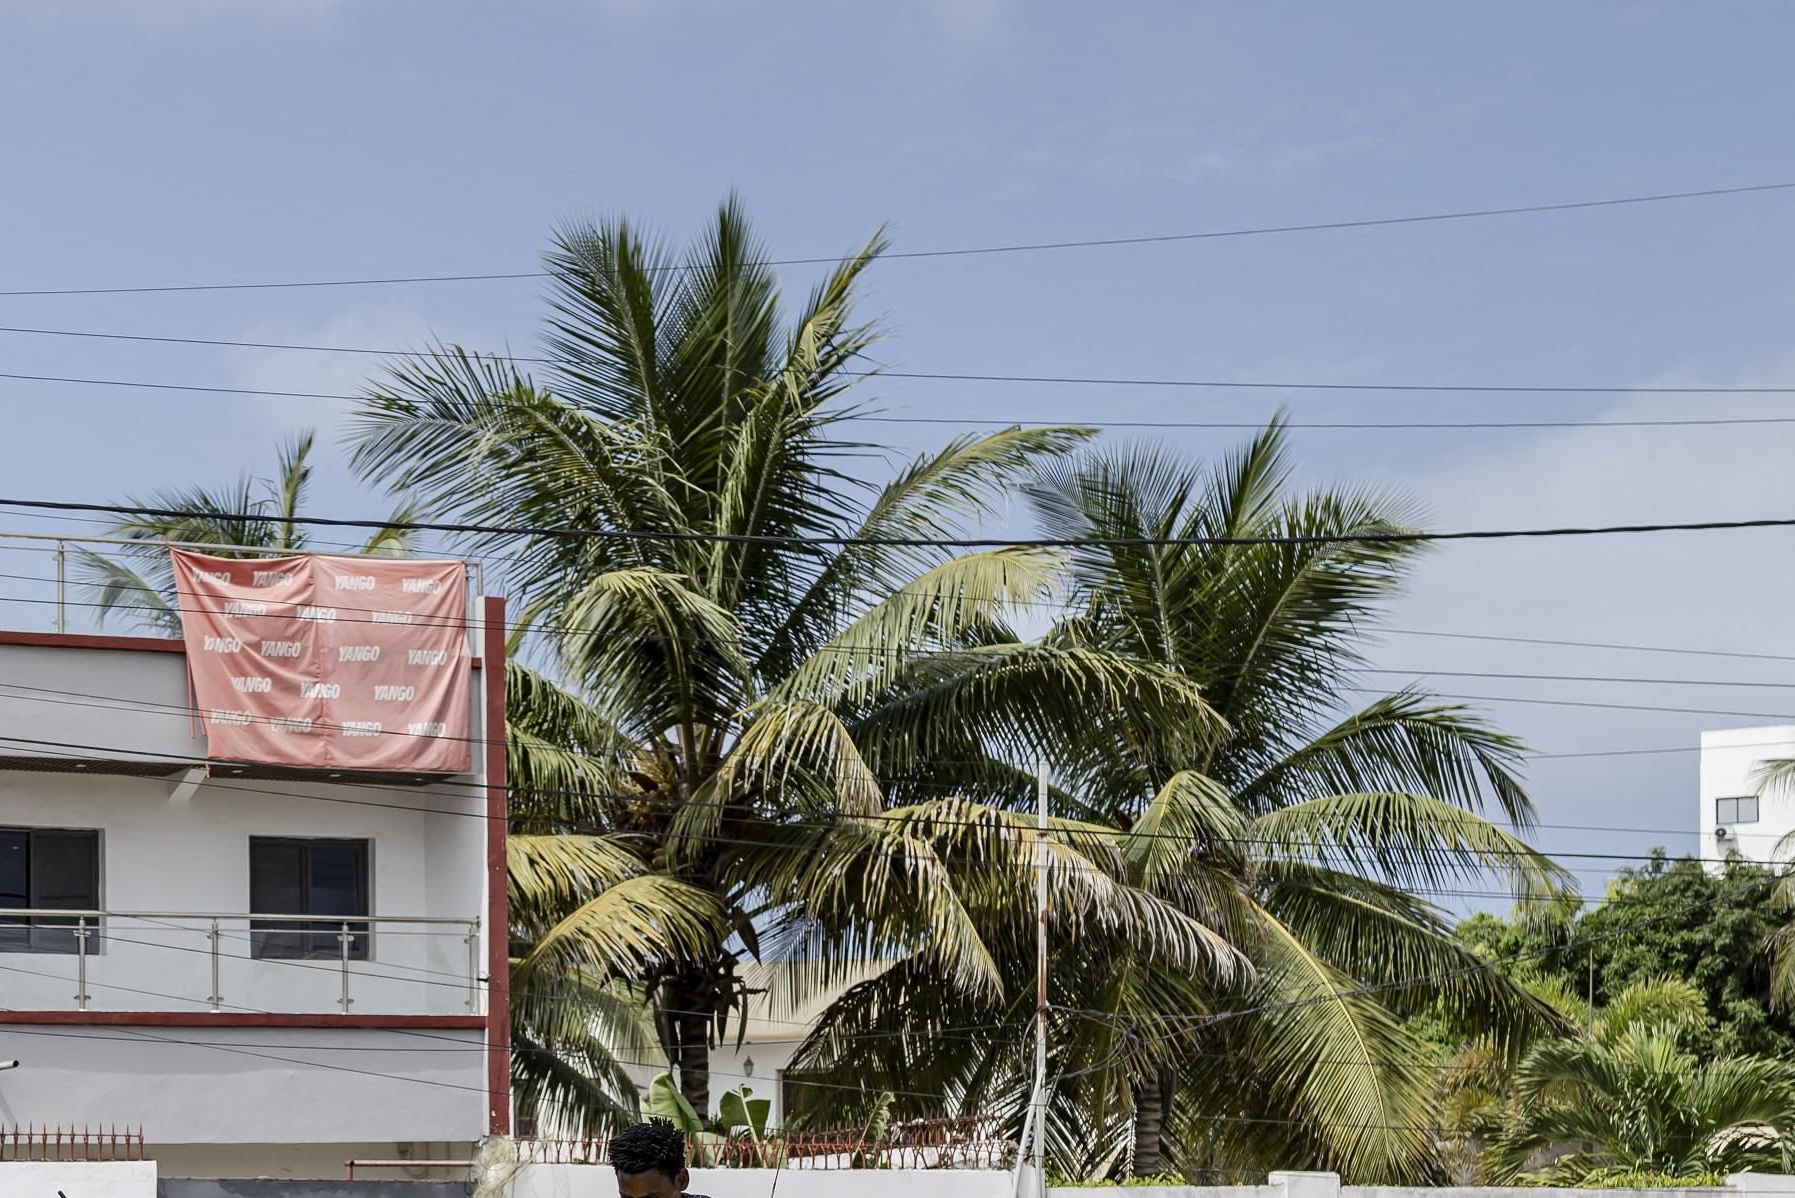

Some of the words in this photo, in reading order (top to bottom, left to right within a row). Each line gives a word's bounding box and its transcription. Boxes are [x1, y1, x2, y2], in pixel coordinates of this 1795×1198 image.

[252, 571, 294, 587] YANGO
[335, 576, 375, 590] YANGO
[402, 579, 442, 594] YANGO
[297, 606, 336, 623] YANGO
[260, 641, 301, 657] YANGO
[339, 646, 380, 662] YANGO
[408, 649, 447, 665] YANGO
[374, 685, 415, 701] YANGO
[408, 722, 446, 738] YANGO
